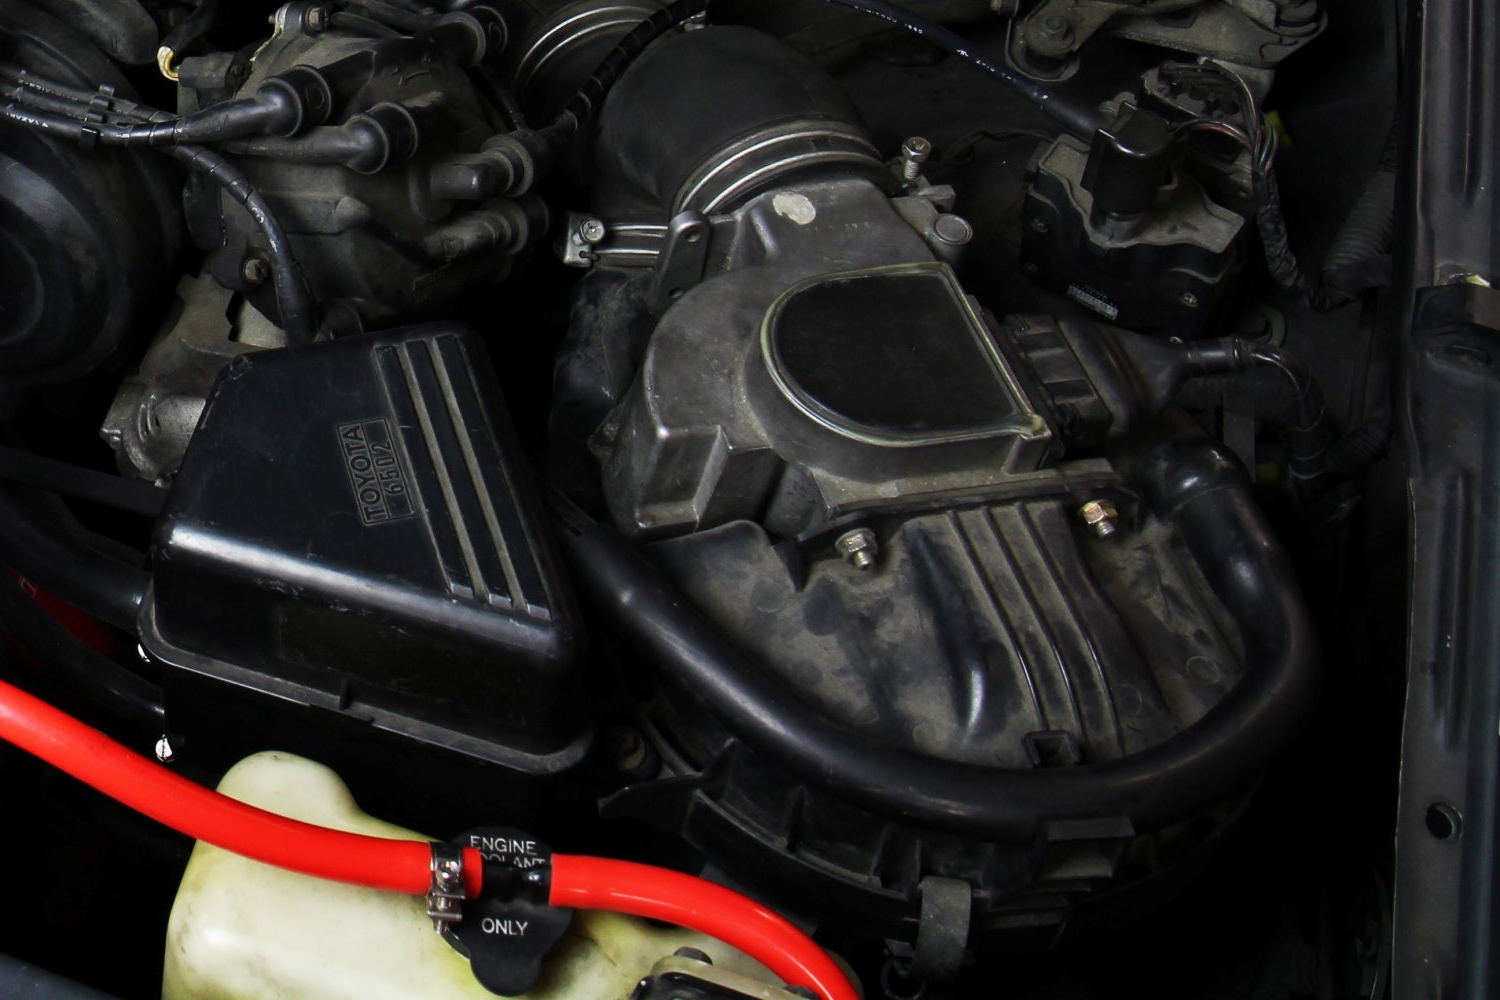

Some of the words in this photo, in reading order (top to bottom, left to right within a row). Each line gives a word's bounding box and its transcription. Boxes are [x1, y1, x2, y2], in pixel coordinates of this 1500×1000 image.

[342, 425, 386, 521] TOYOTA
[371, 441, 405, 496] 6502
[470, 835, 537, 856] ENGINE
[481, 917, 528, 936] ONLY
